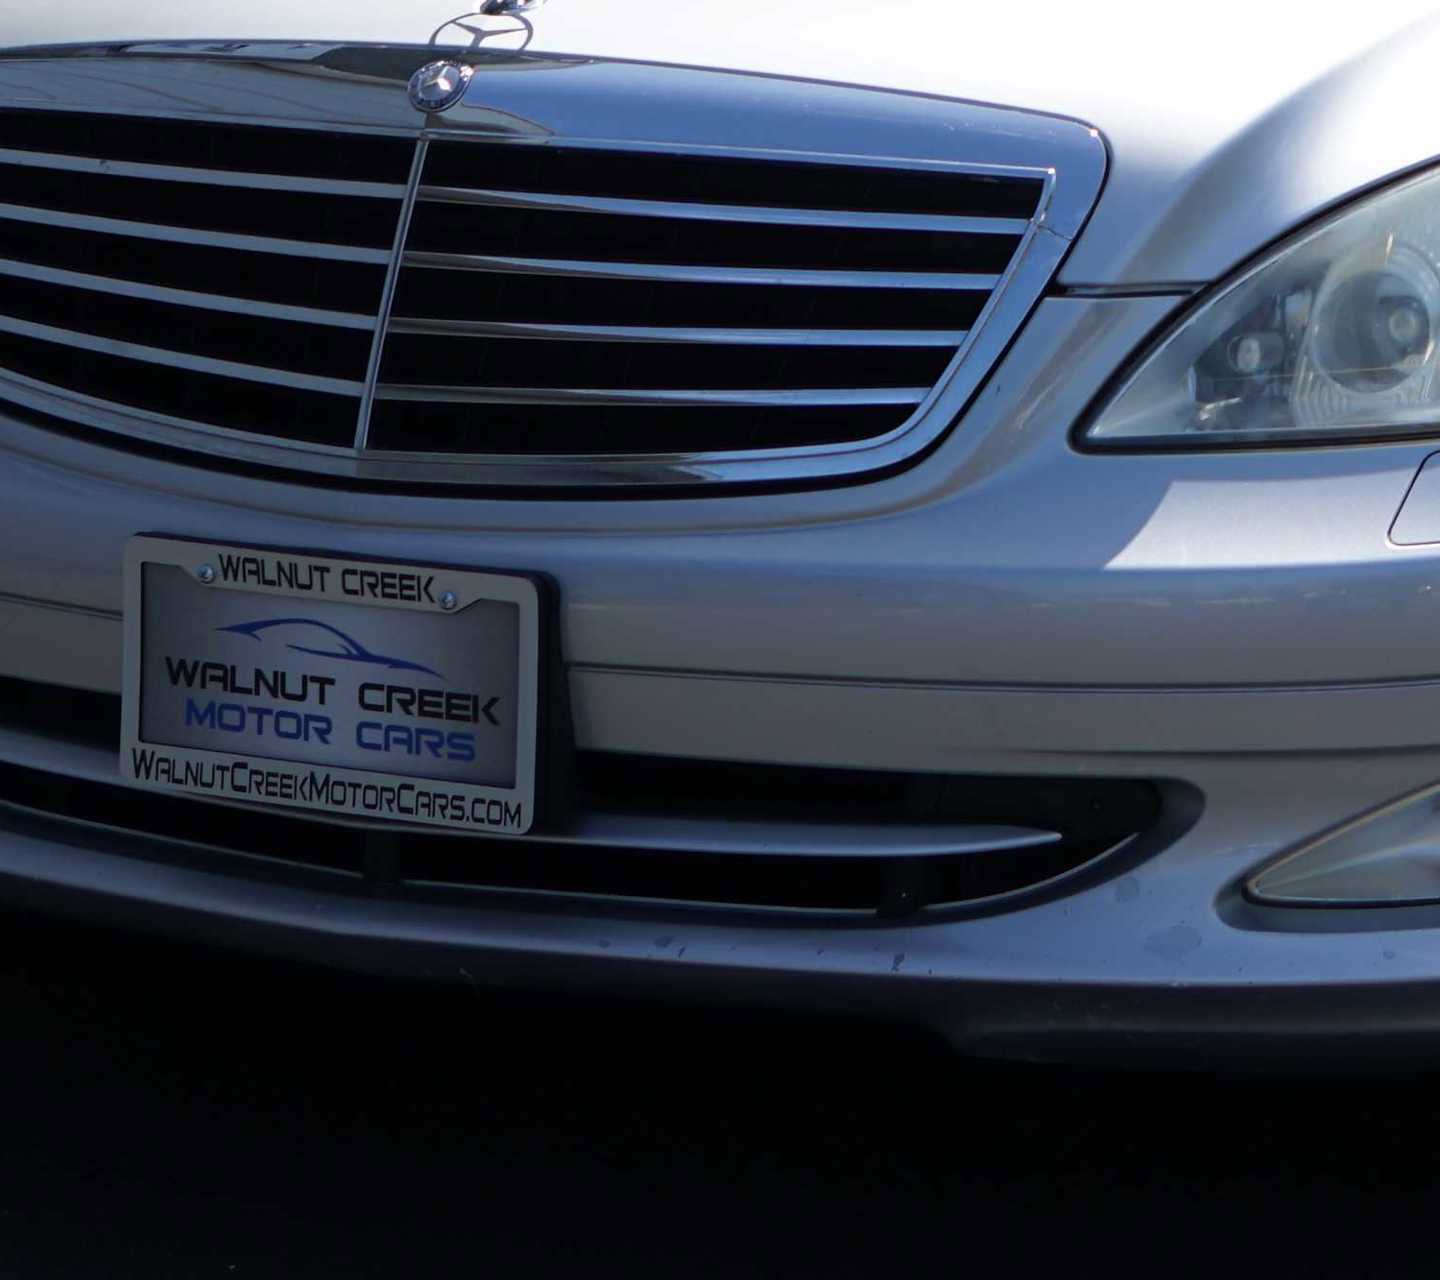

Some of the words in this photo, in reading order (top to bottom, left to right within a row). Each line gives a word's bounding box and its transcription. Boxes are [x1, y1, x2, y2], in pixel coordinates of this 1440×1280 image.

[218, 553, 331, 593] WALNUT
[341, 568, 435, 604] CREEK
[164, 656, 335, 705] WALNUT
[358, 682, 502, 727] CREEK
[184, 697, 333, 745] MOTOR
[356, 721, 477, 762] CARS
